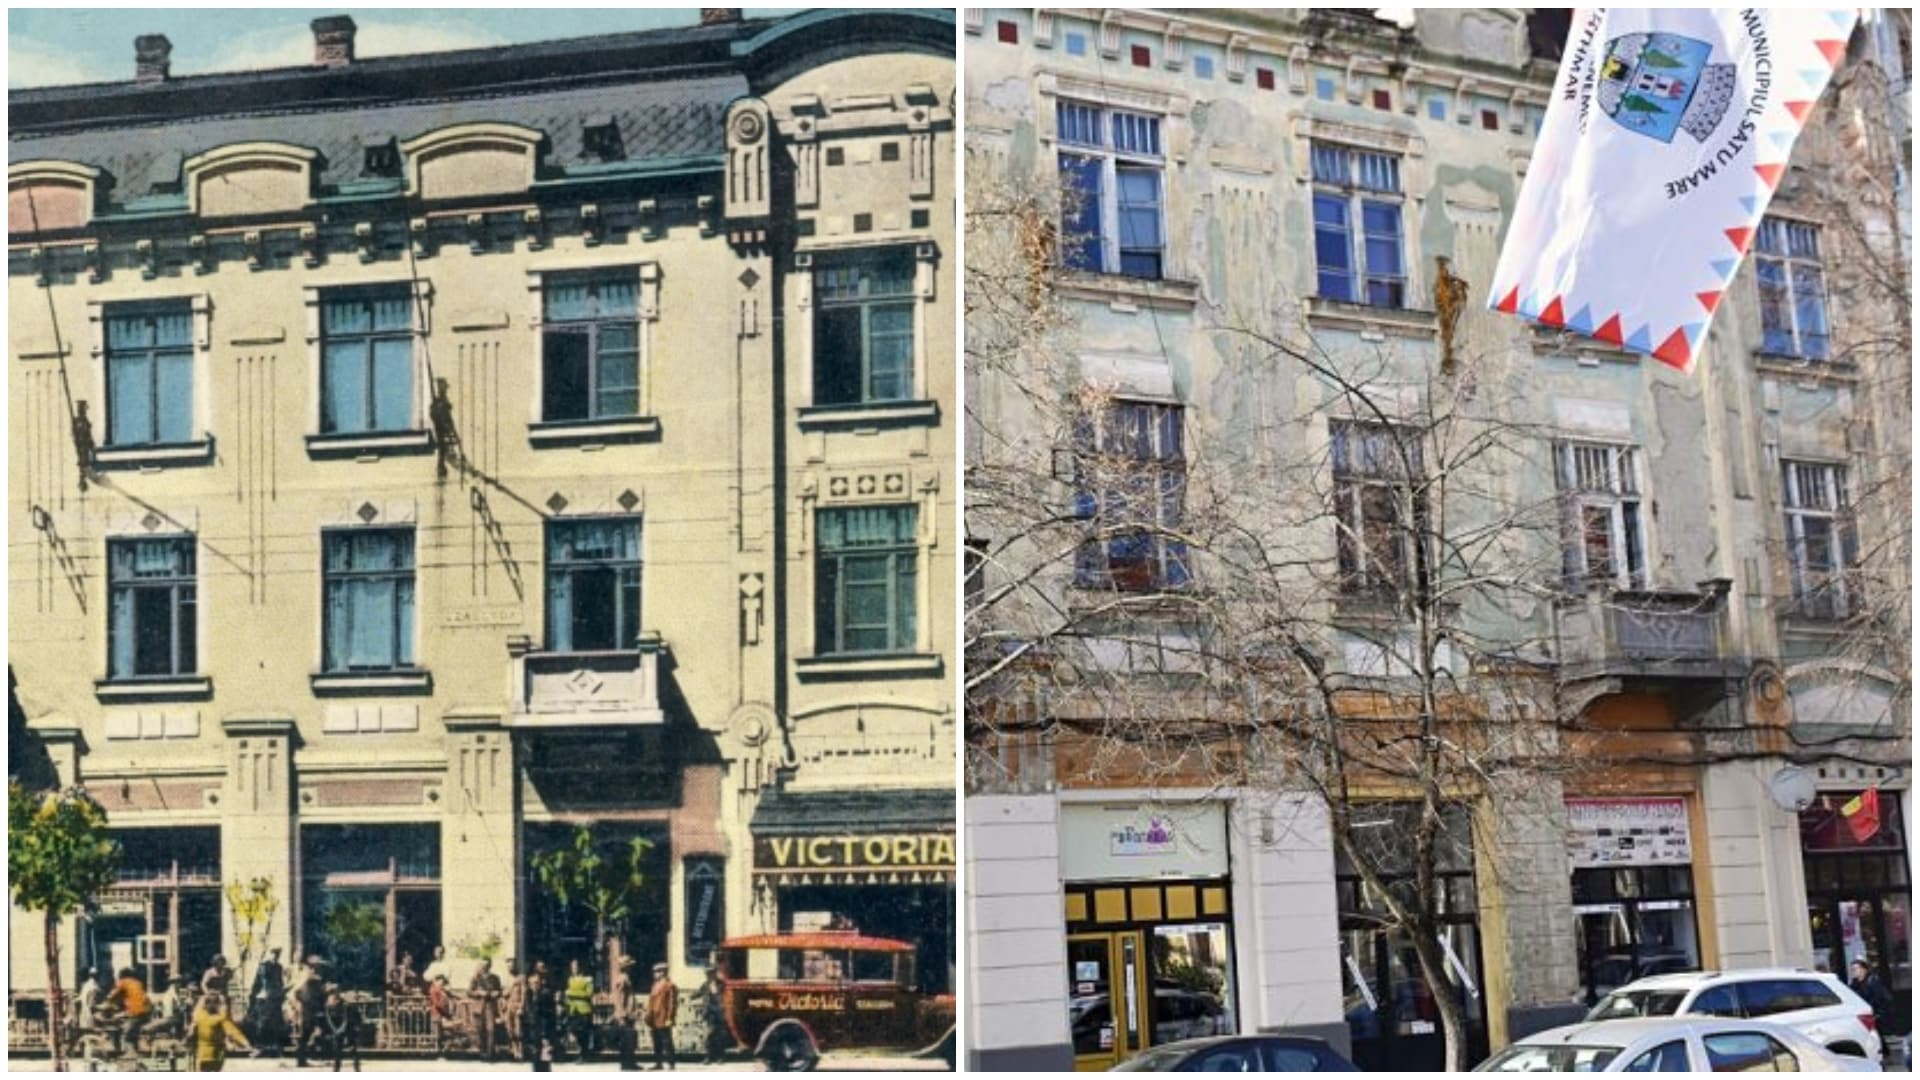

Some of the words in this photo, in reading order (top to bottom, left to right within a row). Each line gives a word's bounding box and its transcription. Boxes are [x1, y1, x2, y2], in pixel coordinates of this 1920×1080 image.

[1740, 8, 1772, 115] MUNICIPIUL
[1717, 119, 1756, 166] SATU
[1665, 160, 1718, 199] MARE
[770, 836, 955, 866] VICTORIA
